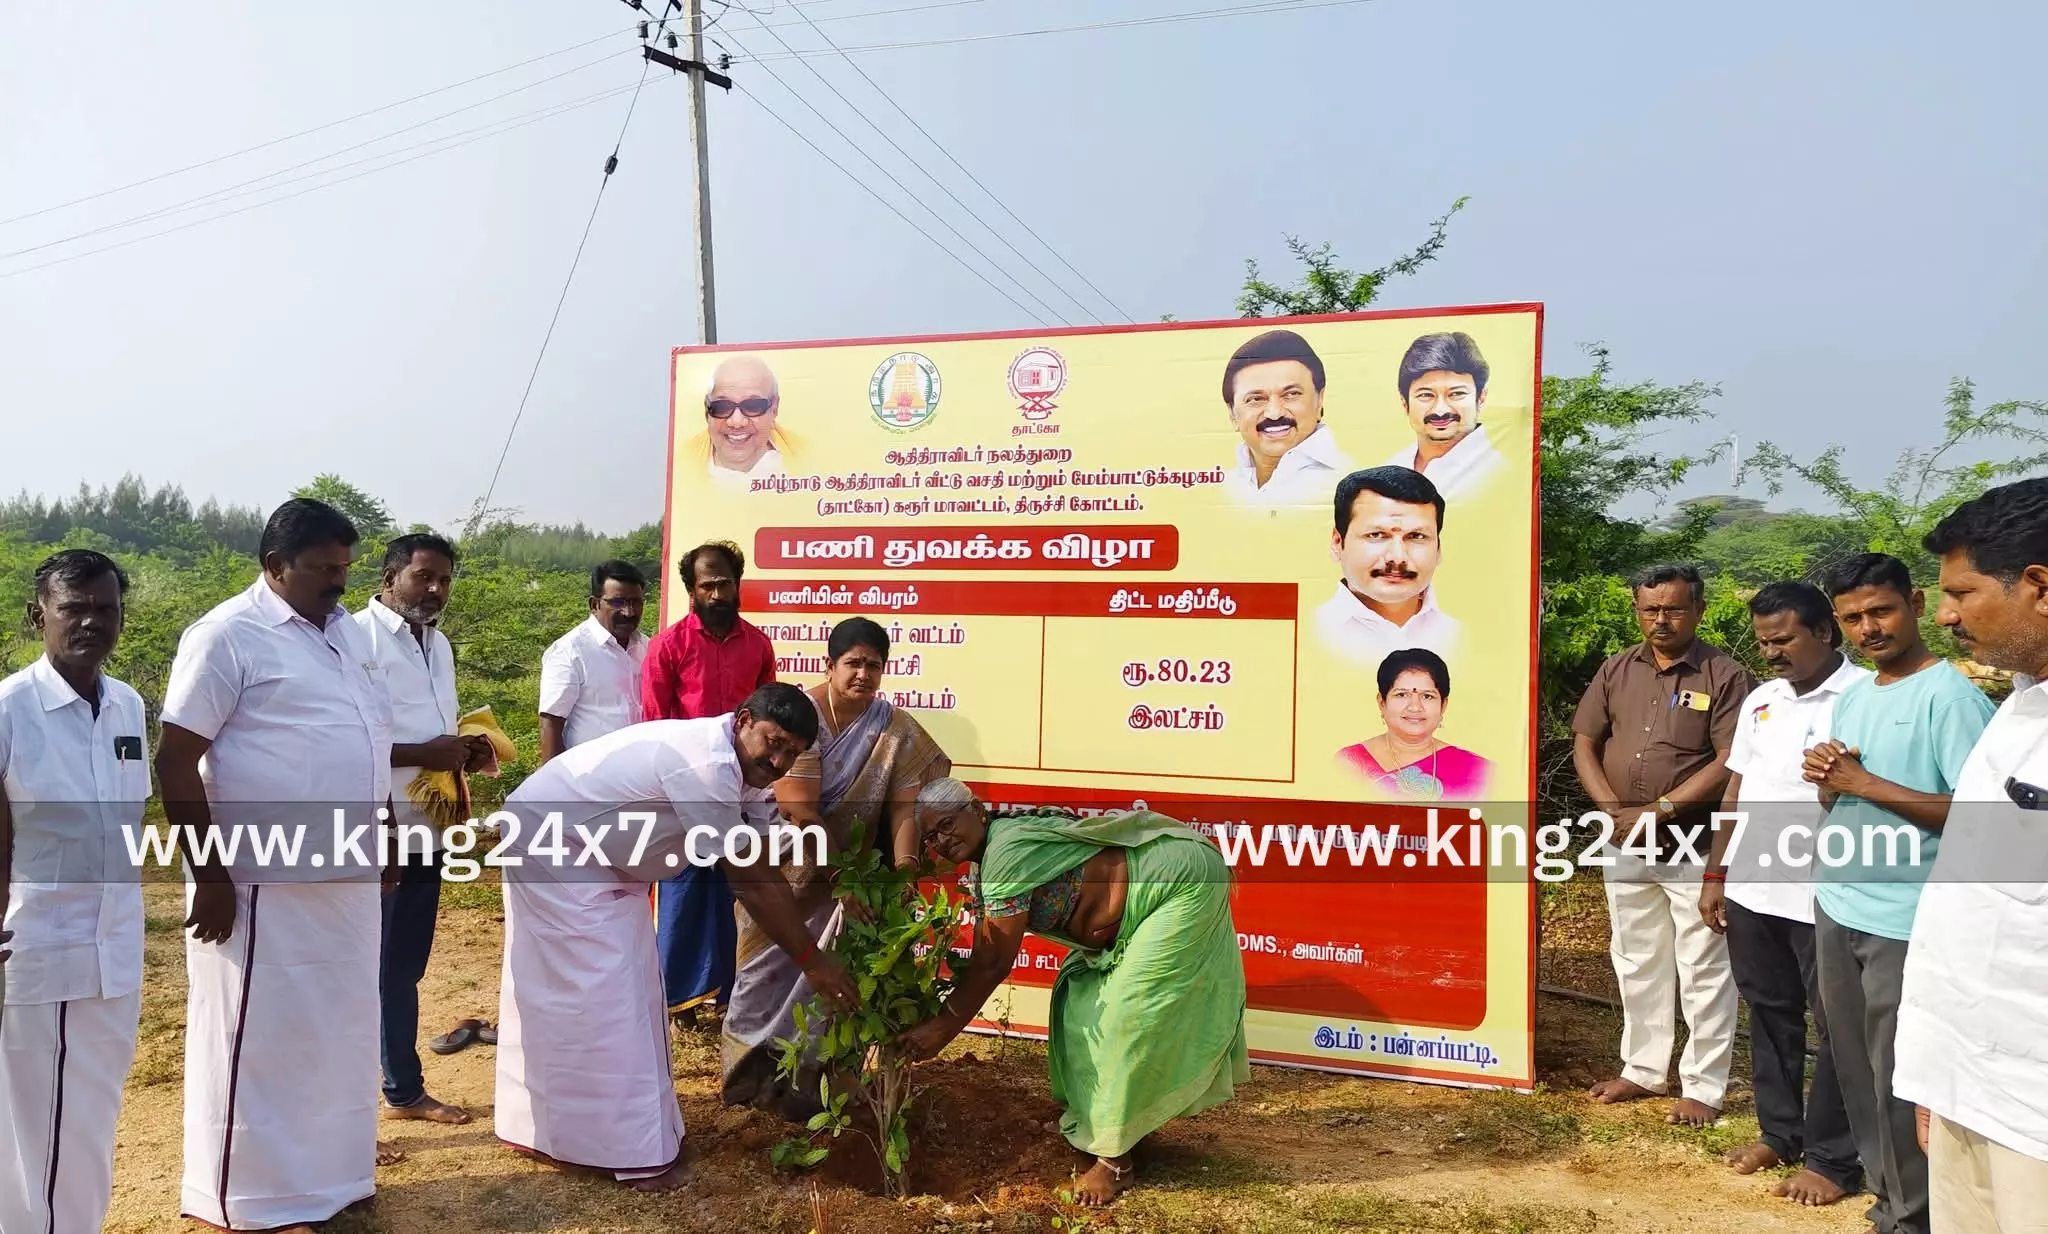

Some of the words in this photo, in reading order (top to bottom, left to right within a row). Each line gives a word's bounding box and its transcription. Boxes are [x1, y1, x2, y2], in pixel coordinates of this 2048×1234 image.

[1012, 421, 1061, 437] தாட்கோ
[885, 445, 983, 466] ஆதிதிராவிடர்
[987, 444, 1072, 465] நலத்துறை
[750, 473, 821, 493] தமிழ்நாடு
[825, 471, 920, 491] ஆதிதிராவிடர்
[925, 470, 963, 489] வீட்டு
[967, 470, 1004, 489] வசதி
[1008, 469, 1067, 490] மற்றும்
[1072, 466, 1225, 488] மேம்பாட்டுக்கழகம்
[817, 497, 890, 516] (தாட்கோ)
[893, 496, 930, 516] கரூர்
[934, 494, 1010, 514] மாவட்டம்,
[1014, 494, 1066, 515] திருச்சி
[1070, 493, 1144, 512] கோட்டம்.
[781, 535, 874, 559] பணி
[883, 534, 1032, 567] துவக்க
[1042, 533, 1155, 567] விழா
[768, 584, 854, 605] பணியின்
[859, 584, 919, 609] விபரம்
[1108, 588, 1153, 612] திட்ட
[1158, 587, 1237, 615] மதிப்பீடு
[909, 622, 965, 644] வட்டம்
[1122, 659, 1231, 687] ரூ.80.23
[1128, 703, 1224, 730] இலட்சம்
[1314, 1026, 1363, 1050] இடம்
[1370, 1034, 1377, 1051] :
[1383, 1031, 1498, 1068] பன்னப்பட்டி.
